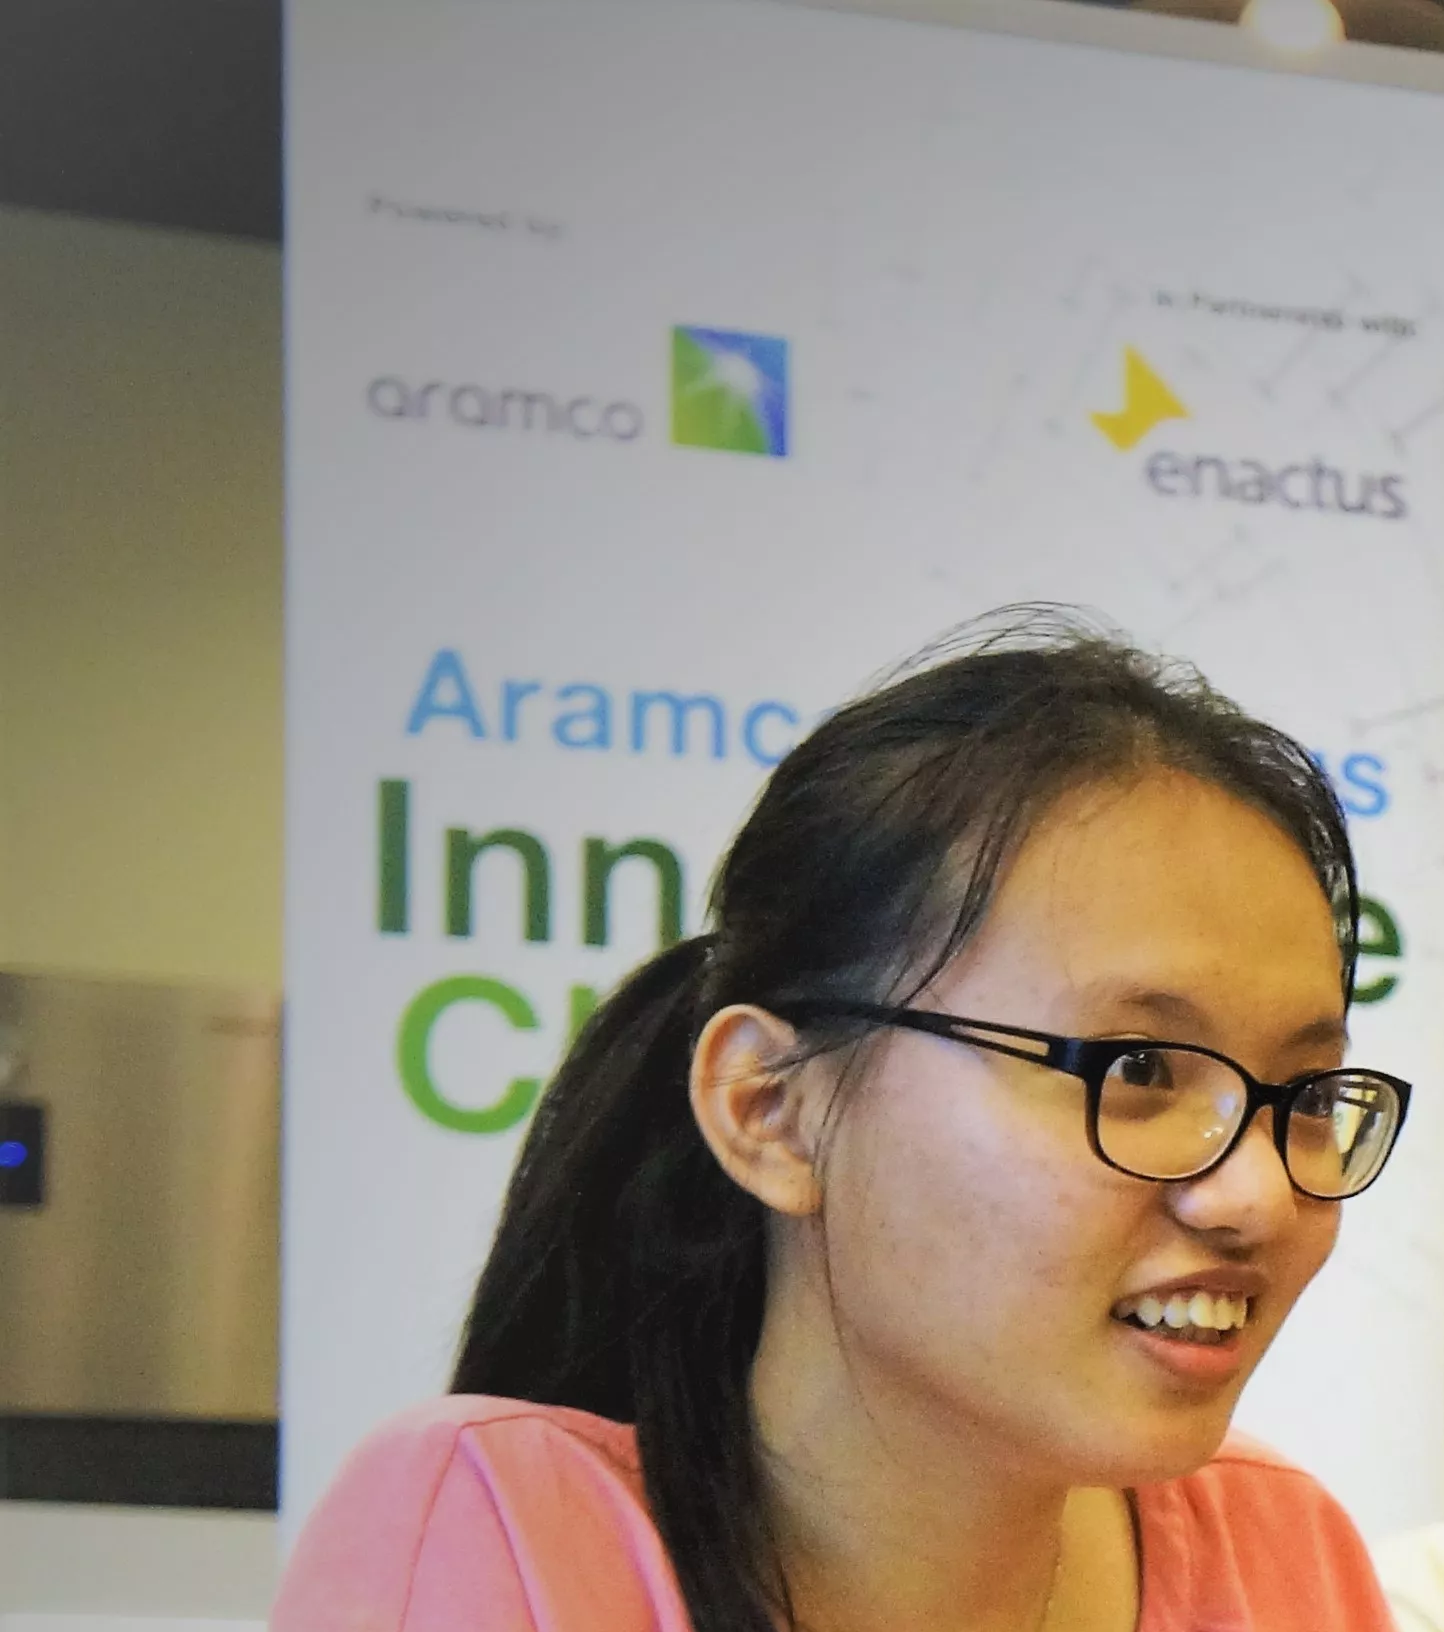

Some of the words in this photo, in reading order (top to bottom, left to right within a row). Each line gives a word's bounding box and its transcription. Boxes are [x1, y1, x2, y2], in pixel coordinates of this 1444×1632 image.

[366, 376, 645, 442] aramco
[1146, 450, 1409, 520] enactus
[404, 646, 801, 770] Aramc
